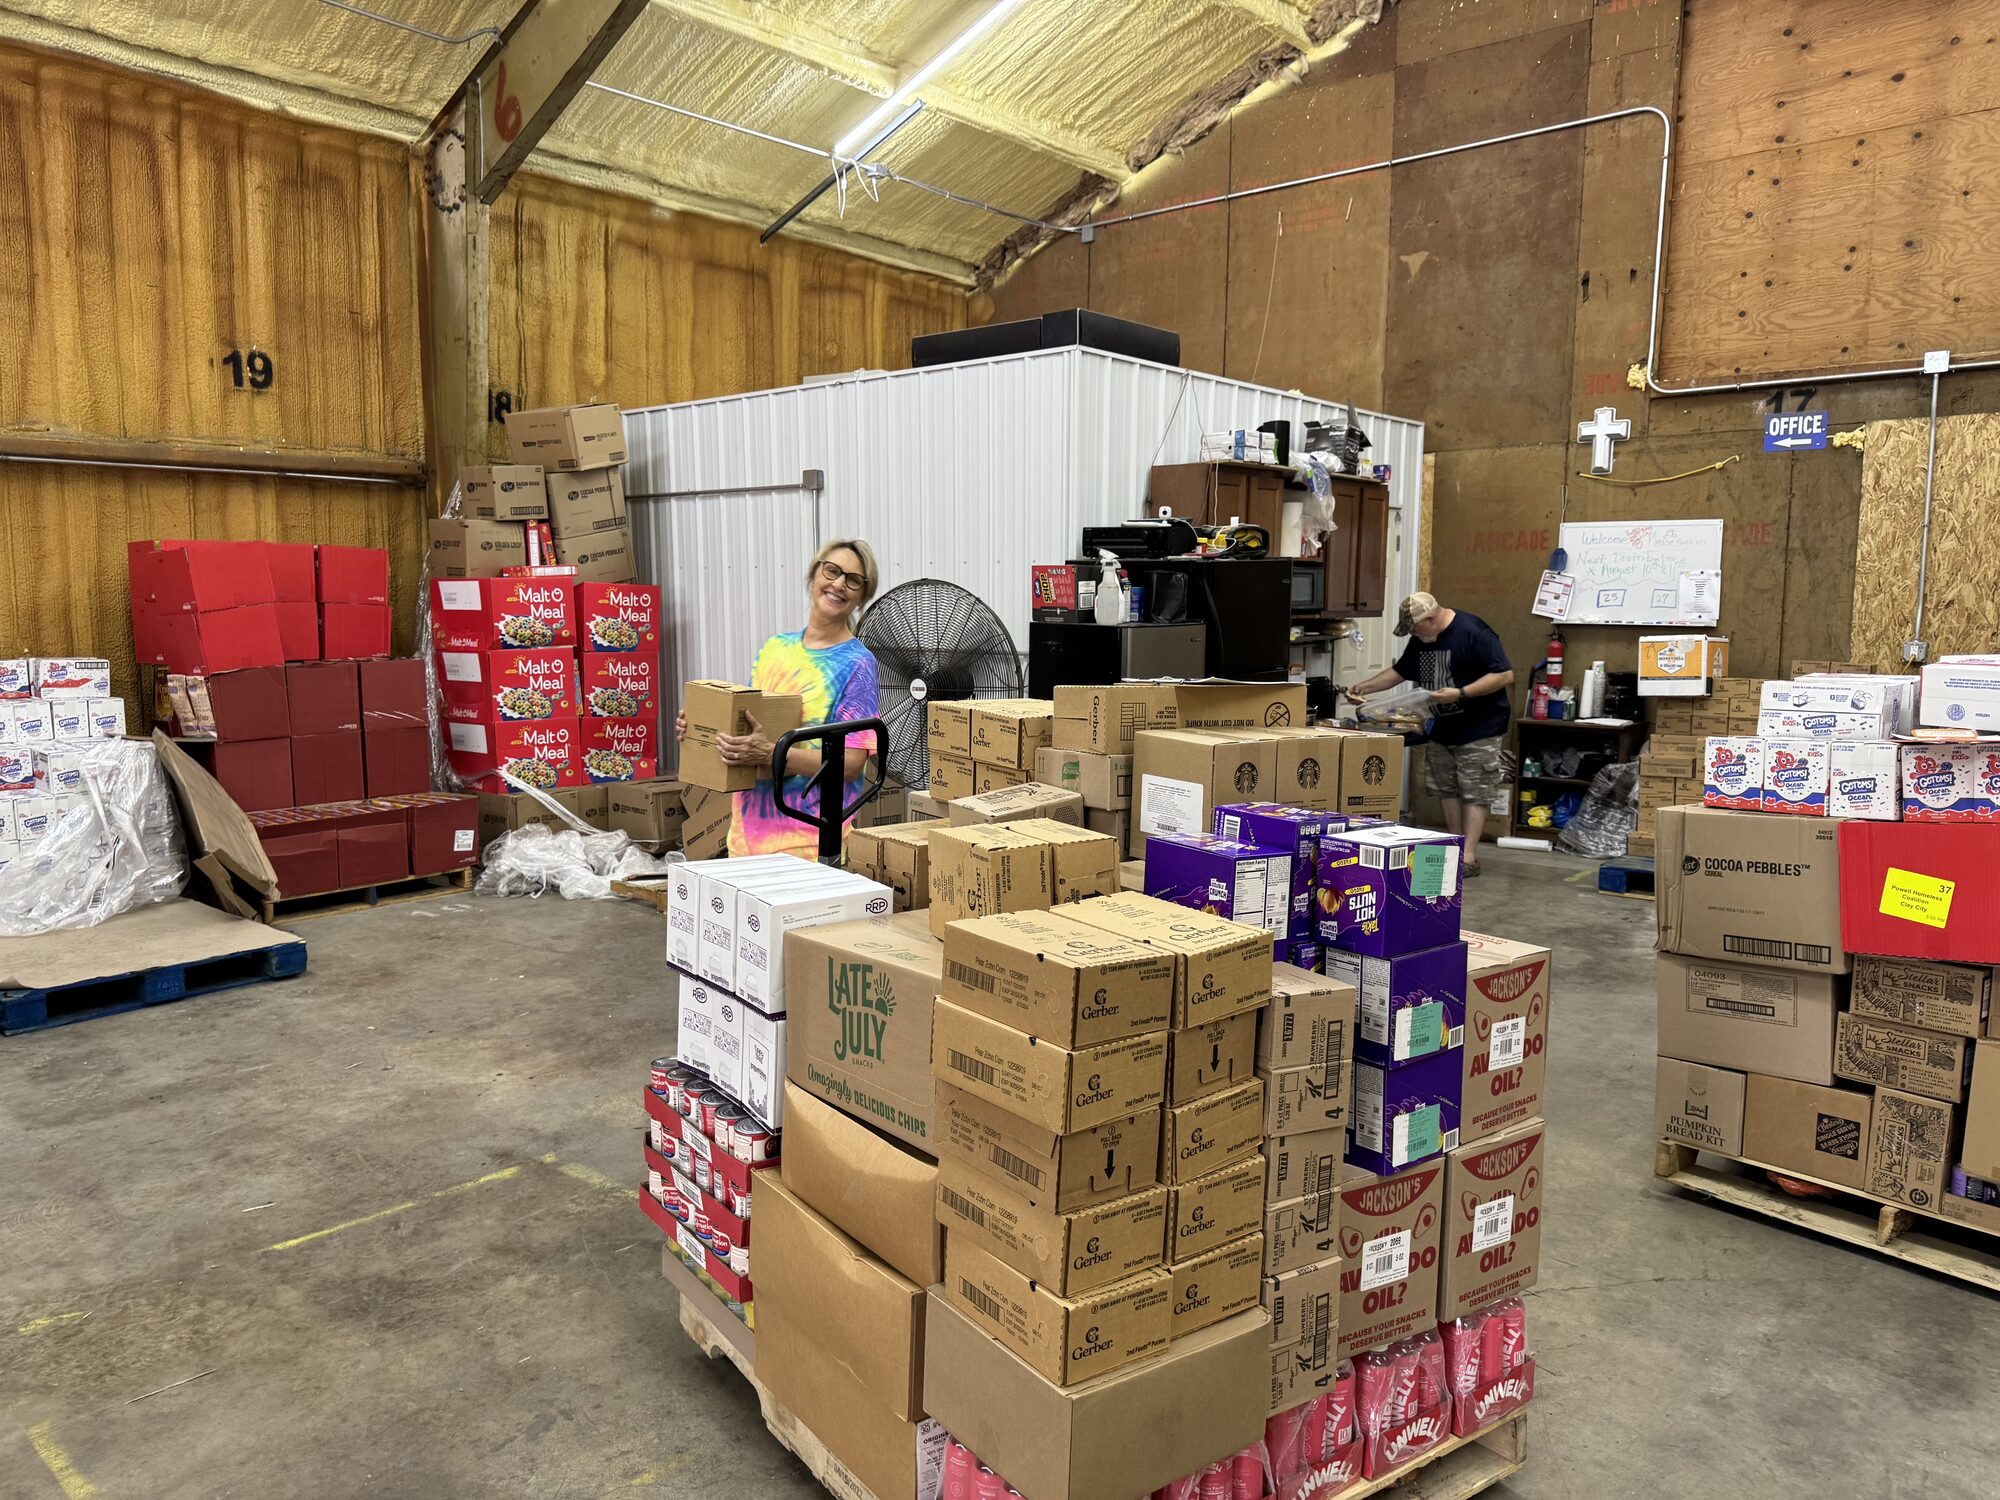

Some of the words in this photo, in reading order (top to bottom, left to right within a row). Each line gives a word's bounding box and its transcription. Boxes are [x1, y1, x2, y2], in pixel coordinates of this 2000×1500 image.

[494, 61, 522, 142] 6
[223, 350, 274, 390] 19
[1766, 388, 1817, 413] 17
[1769, 414, 1823, 435] OFFICE
[580, 488, 594, 496] COCOA
[1582, 533, 1629, 545] Welcome
[1576, 552, 1608, 565] Next
[1601, 564, 1636, 579] August
[519, 587, 550, 603] Malt
[552, 588, 563, 602] O
[1040, 573, 1052, 603] SHOP
[610, 592, 639, 607] Malt
[640, 594, 651, 607] O
[530, 604, 565, 619] Meal
[619, 608, 651, 622] Meal
[518, 658, 550, 675] Malt
[552, 659, 564, 674] O
[609, 662, 638, 676] Malt
[639, 662, 649, 676] O
[529, 675, 565, 690] Meal
[619, 677, 650, 691] Meal
[606, 725, 634, 738] Malt
[635, 724, 647, 737] O
[1186, 719, 1202, 728] KNIFE
[1204, 719, 1219, 727] WITH
[1220, 719, 1232, 727] CUT
[1234, 719, 1245, 727] NOT
[1246, 718, 1254, 727] DO
[524, 730, 556, 746] Malt
[557, 729, 569, 743] O
[613, 739, 645, 752] Meal
[534, 746, 570, 760] Meal
[1705, 858, 1744, 872] COCOA
[1209, 889, 1227, 900] CRUNCH
[1892, 885, 1912, 894] Powell
[1913, 891, 1943, 902] Homeless
[1939, 885, 1952, 895] 37
[866, 900, 888, 913] RRP
[1349, 891, 1377, 911] NUTS
[1900, 901, 1914, 910] Clay
[1915, 905, 1928, 913] City
[1902, 894, 1929, 905] Coalition
[1355, 906, 1376, 923] HOT
[1488, 968, 1532, 1000] JACKSON'S
[1694, 970, 1726, 981] 04093
[1898, 968, 1940, 986] Stellar
[828, 956, 874, 1016] LATE
[1904, 982, 1939, 993] SNACKS
[834, 1007, 890, 1062] JULY
[1881, 1031, 1922, 1051] Stellar
[1310, 1020, 1318, 1071] STRAWBERRY
[1886, 1046, 1921, 1058] SNACKS
[852, 1059, 874, 1070] SNACKS
[1490, 1066, 1524, 1097] OIL?
[808, 1063, 853, 1103] Amazingly
[854, 1090, 896, 1123] DELICIOUS
[898, 1111, 927, 1138] CHIPS
[1472, 1107, 1499, 1125] BECAUSE
[1499, 1101, 1514, 1115] YOUR
[1515, 1093, 1537, 1108] SNACKS
[1325, 1106, 1344, 1119] 4
[1481, 1114, 1506, 1131] DESERVE
[1507, 1107, 1528, 1122] BETTER.
[1670, 1115, 1722, 1137] PUMPKIN
[1817, 1130, 1838, 1142] SINGLE
[1837, 1123, 1856, 1136] SERVE
[1666, 1124, 1703, 1143] BREAD
[1705, 1133, 1726, 1147] KIT
[1477, 1142, 1527, 1177] JACKSON'S
[1359, 1177, 1421, 1213] JACKSON'S
[1316, 1238, 1334, 1251] 4
[1390, 1236, 1402, 1248] 2069
[1480, 1241, 1517, 1274] OIL?
[1459, 1284, 1488, 1303] BECAUSE
[1489, 1276, 1506, 1290] YOUR
[1506, 1266, 1531, 1281] SNACKS
[1362, 1282, 1408, 1315] OIL?
[1469, 1290, 1497, 1308] DESERVE
[1497, 1281, 1521, 1296] BETTER.
[1274, 1296, 1284, 1325] 16777
[1338, 1326, 1372, 1345] BECAUSE
[1373, 1319, 1395, 1335] YOUR
[1396, 1309, 1427, 1327] SNACKS
[1350, 1332, 1383, 1351] DESERVE
[1384, 1324, 1414, 1341] BETTER.
[1315, 1373, 1332, 1387] 4
[1474, 1378, 1526, 1420] UNWELL
[1384, 1416, 1441, 1462] UNWELL
